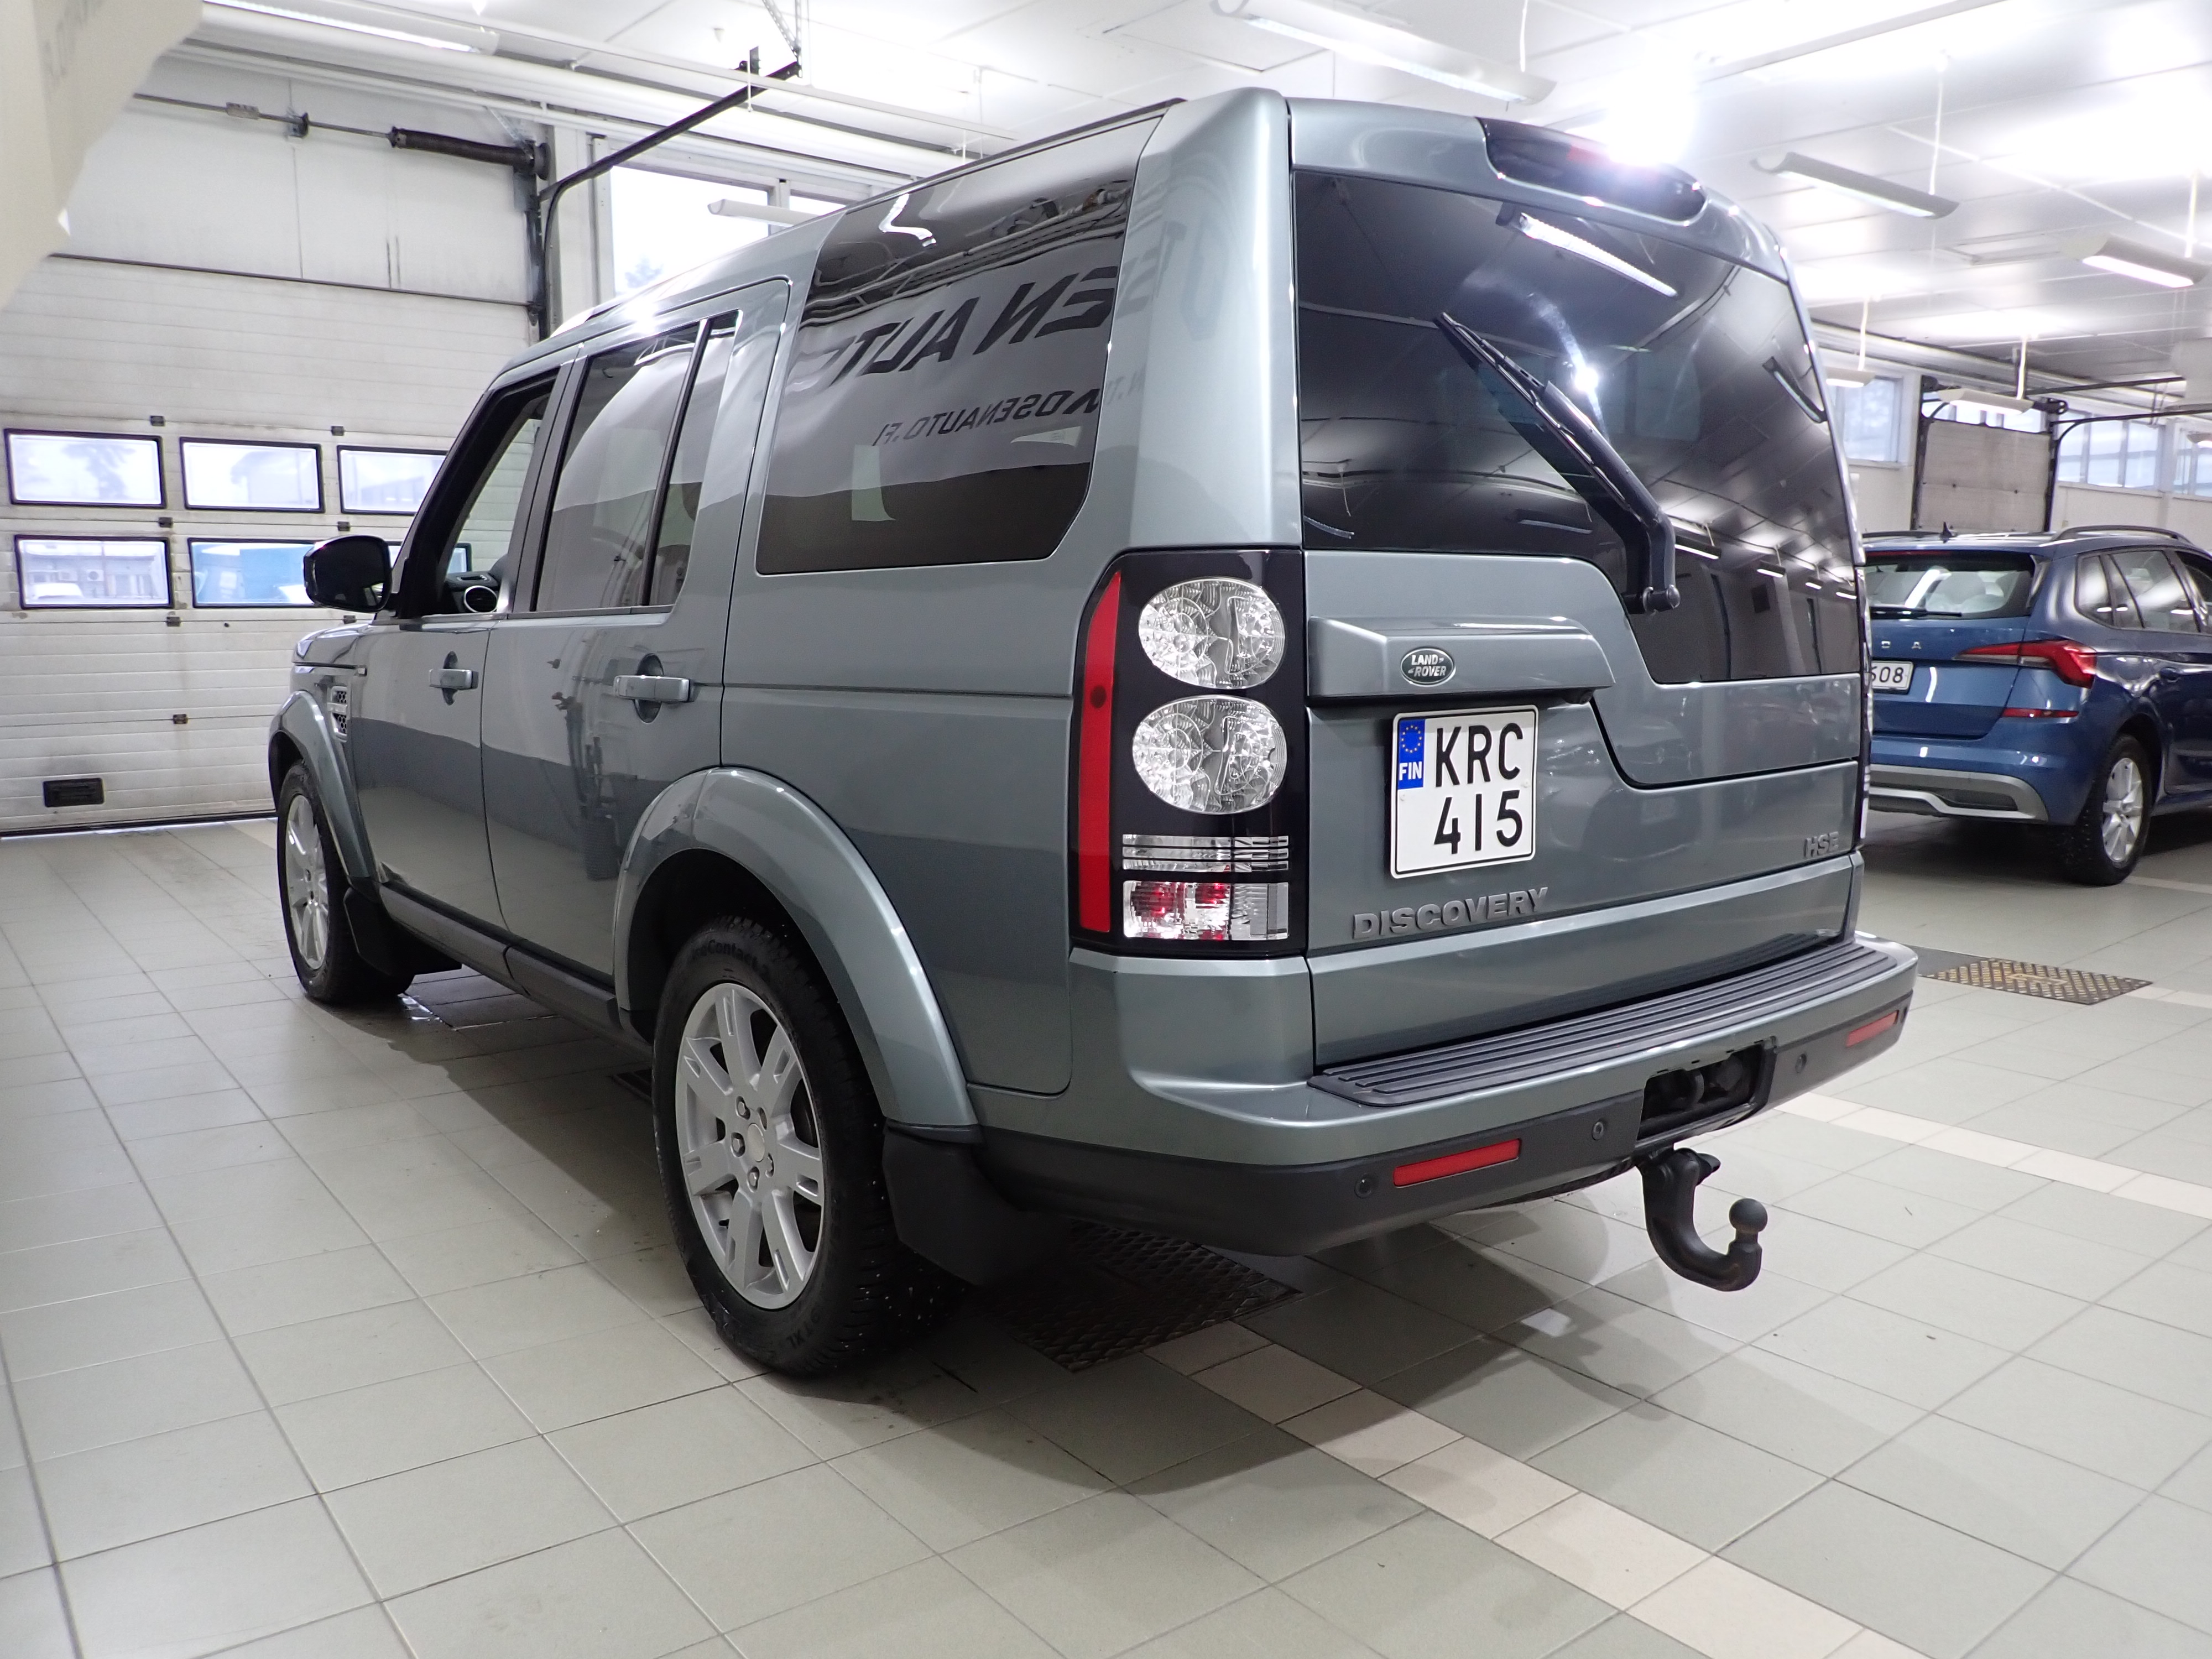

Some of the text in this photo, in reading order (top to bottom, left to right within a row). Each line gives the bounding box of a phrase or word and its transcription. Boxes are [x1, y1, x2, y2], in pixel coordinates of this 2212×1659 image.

[1411, 654, 1438, 665] LAND
[1413, 665, 1447, 677] ROVER
[1434, 722, 1524, 788] KRC
[1399, 760, 1423, 781] FIN
[1433, 789, 1522, 854] 415
[1803, 831, 1839, 858] HSE
[1353, 886, 1548, 940] DISCOVERY
